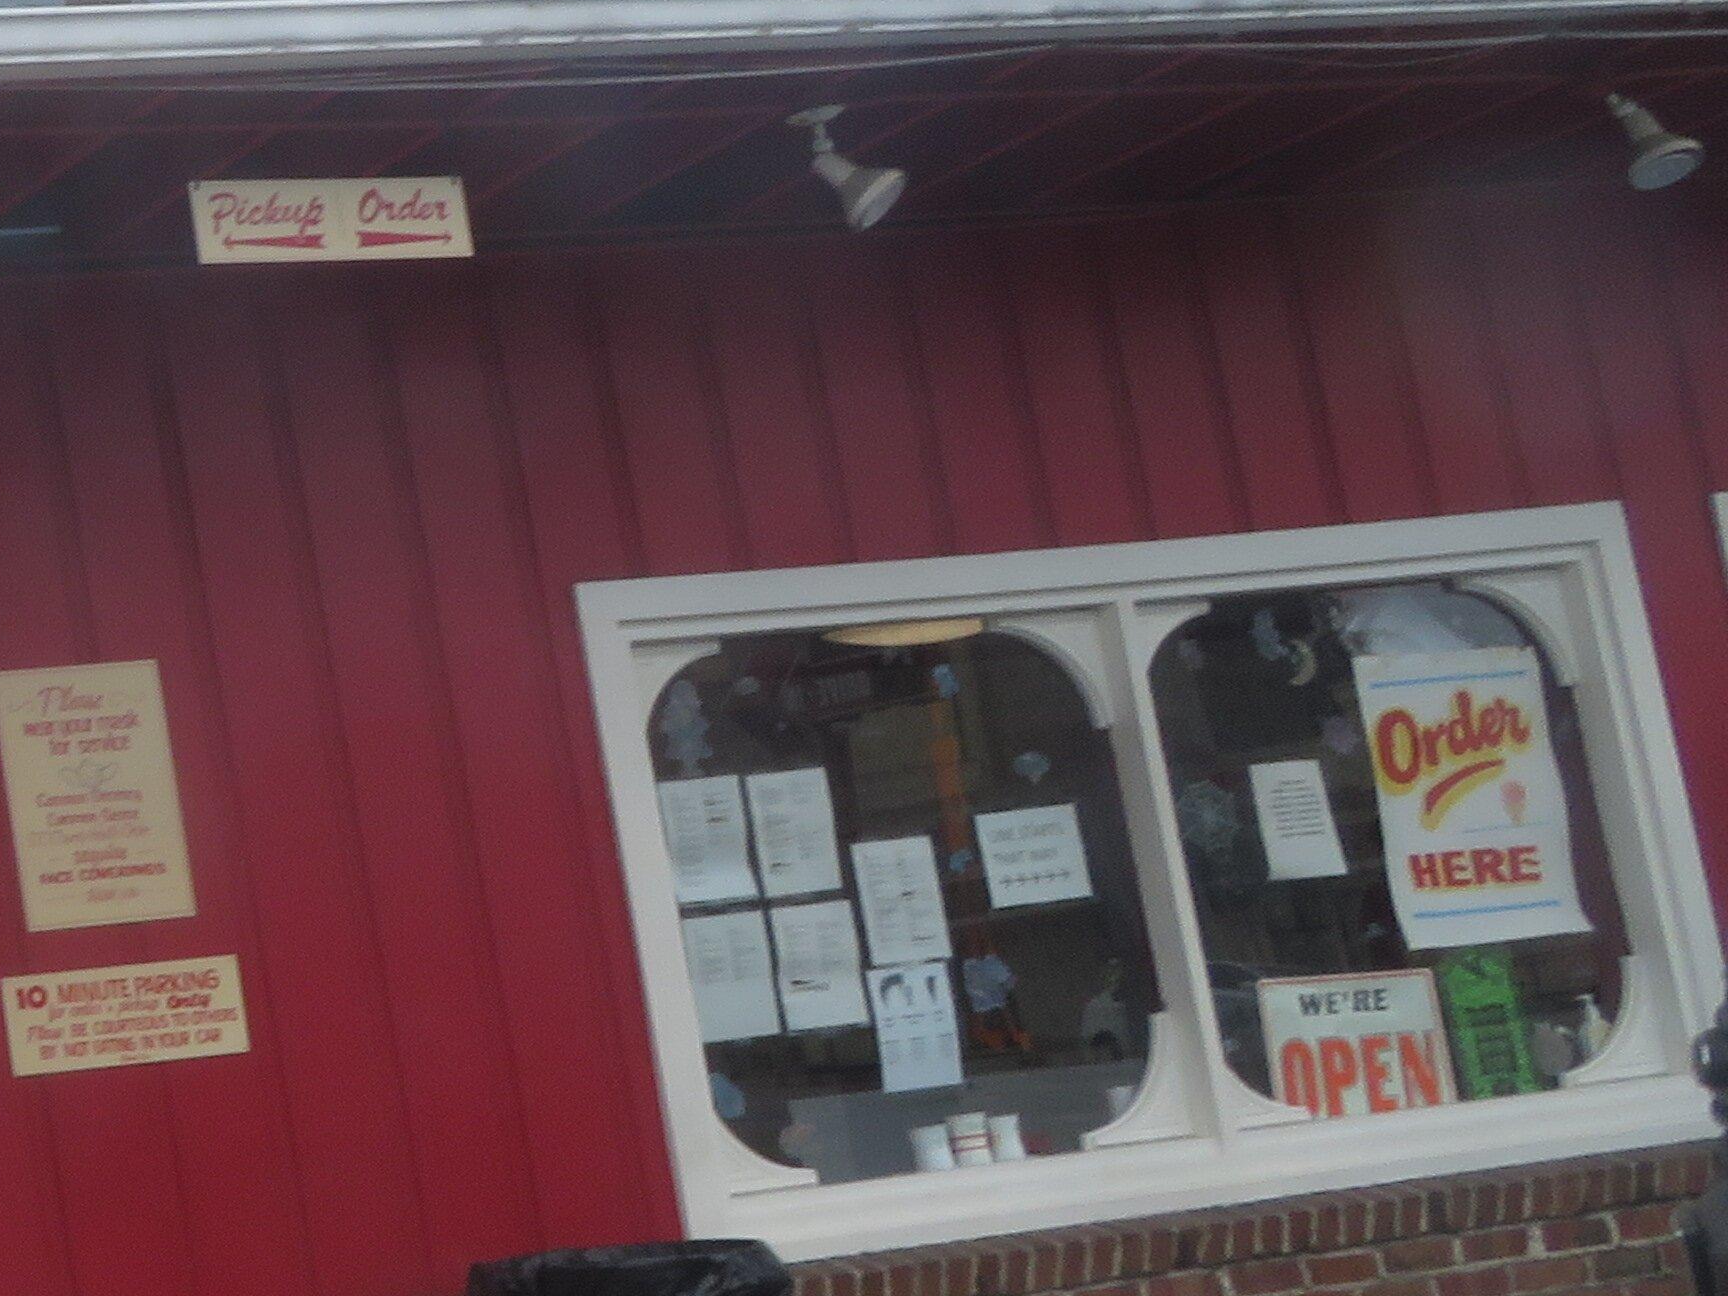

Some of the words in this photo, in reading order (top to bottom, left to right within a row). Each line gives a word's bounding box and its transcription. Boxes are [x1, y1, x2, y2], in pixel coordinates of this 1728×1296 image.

[209, 189, 325, 235] Pickup
[356, 187, 450, 224] Order
[1373, 688, 1533, 790] Order
[1405, 843, 1543, 892] HERE
[16, 985, 48, 1011] 10
[133, 967, 221, 996] PARKING
[1298, 987, 1390, 1018] WE'RE
[1280, 1027, 1444, 1119] OPEN
